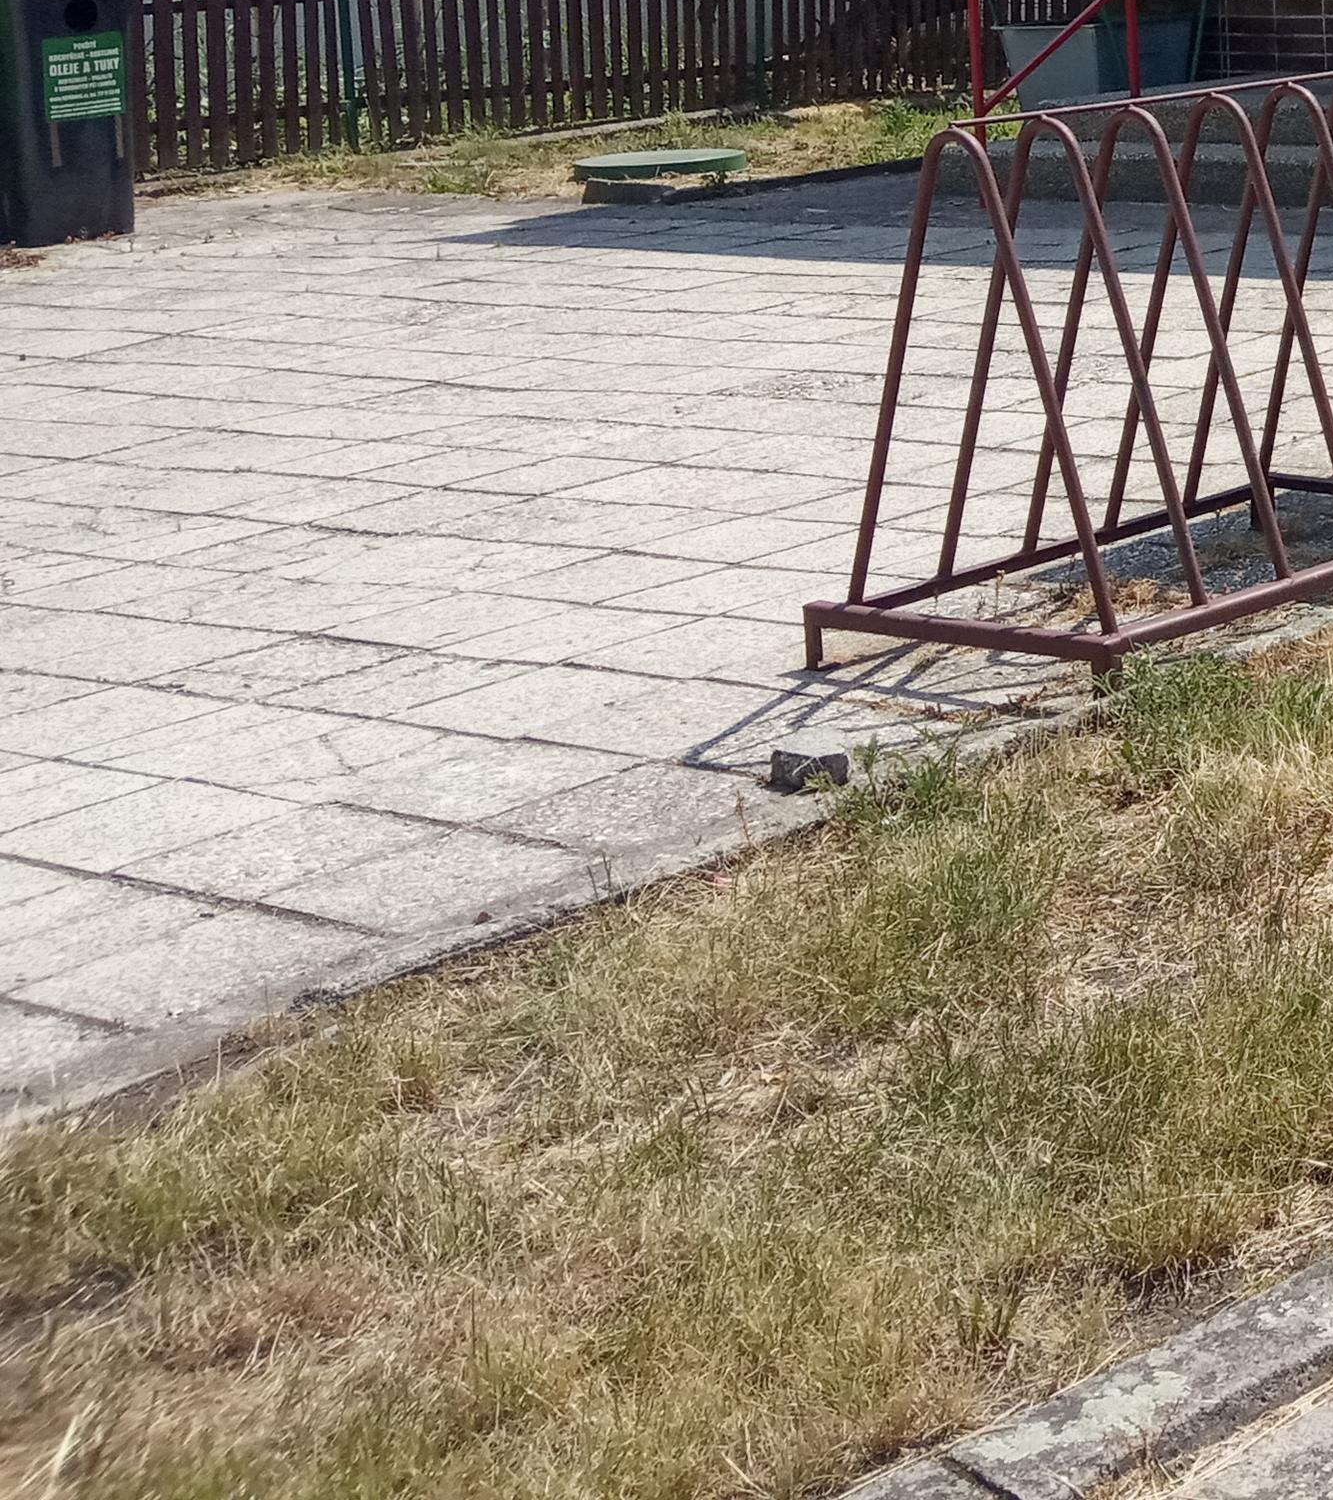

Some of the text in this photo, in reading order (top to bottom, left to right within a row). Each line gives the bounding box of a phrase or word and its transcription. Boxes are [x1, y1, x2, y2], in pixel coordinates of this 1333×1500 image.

[49, 57, 120, 77] OLEJE A TUKY
